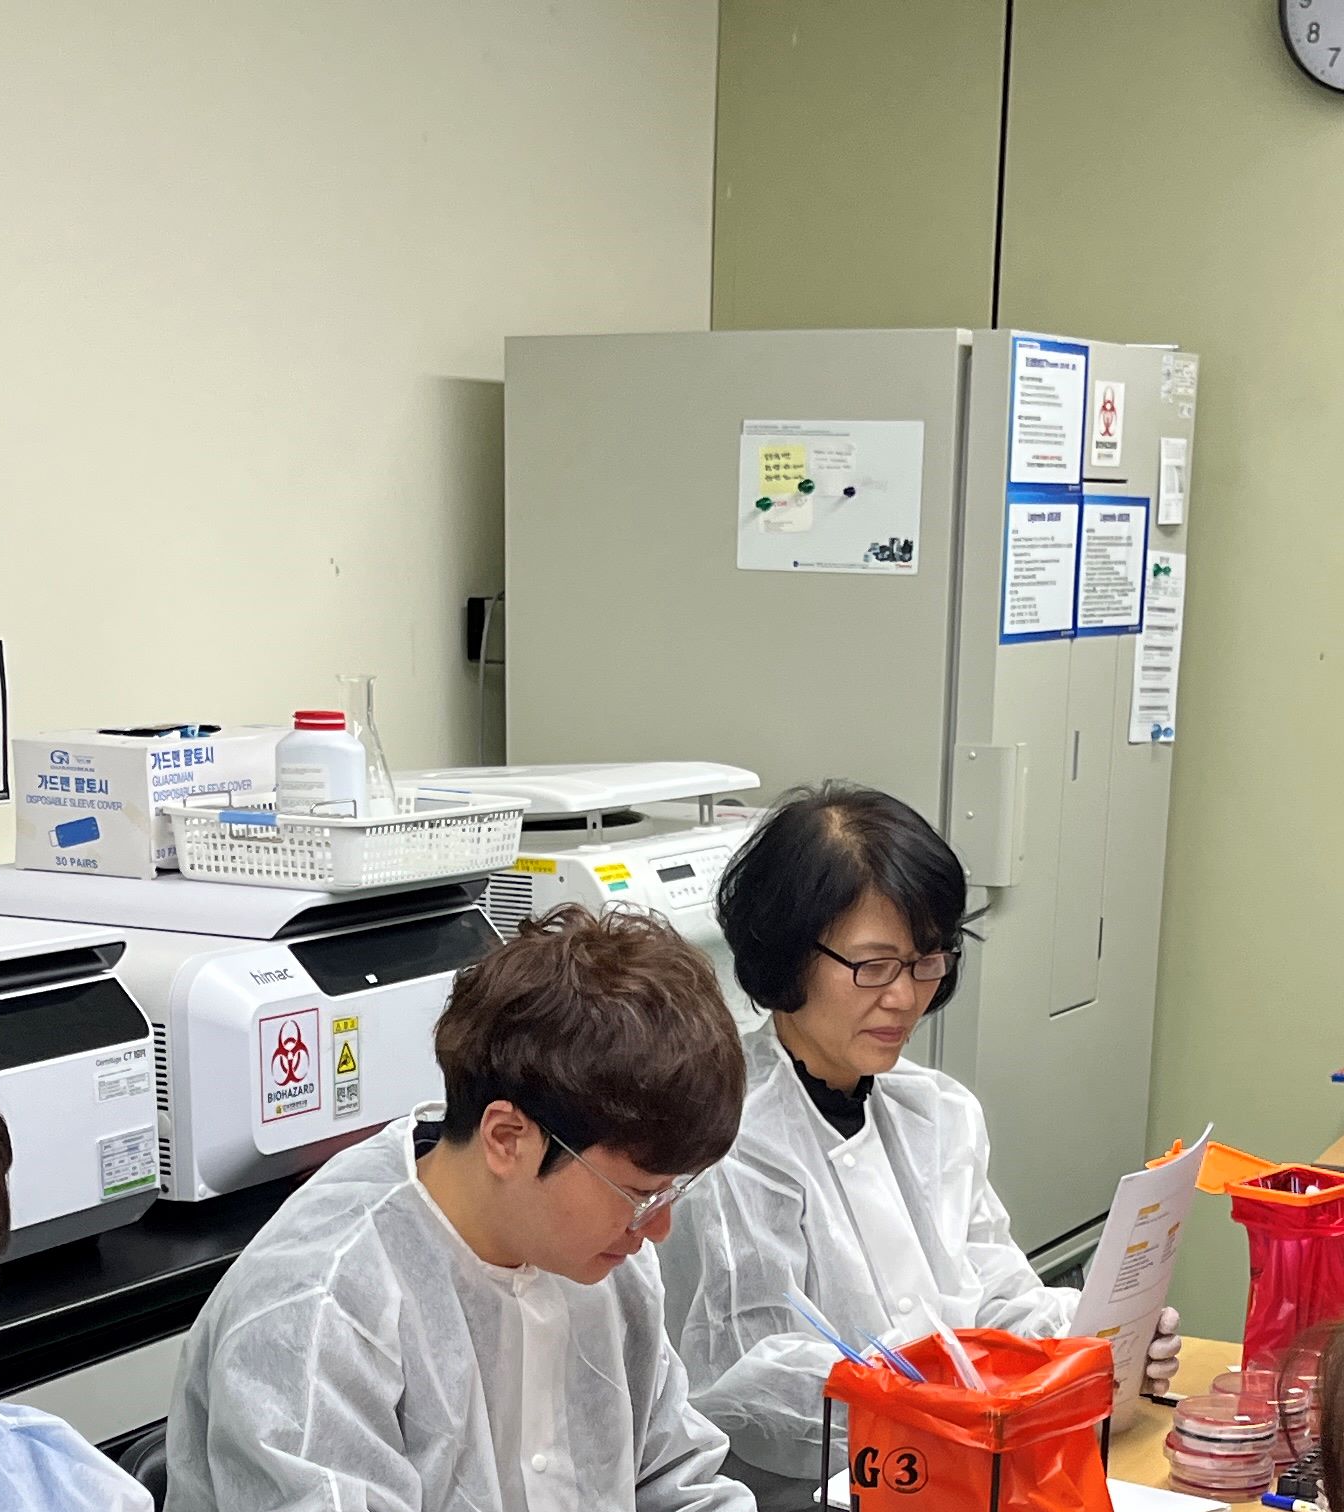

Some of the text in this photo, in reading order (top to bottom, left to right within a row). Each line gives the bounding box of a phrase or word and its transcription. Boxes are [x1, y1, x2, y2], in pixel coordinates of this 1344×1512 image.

[1307, 22, 1320, 43] 8
[1328, 47, 1342, 67] 7
[150, 746, 214, 770] 가드맨 팔토시
[38, 774, 109, 795] 가드맨 팔토시
[152, 771, 194, 787] GUARDMAN
[153, 785, 196, 802] DISPOSABLE
[227, 779, 252, 792] COVER
[26, 794, 123, 811] DISPOSABLE SLEEVE COVER
[56, 856, 98, 868] 30 PAIRS
[249, 968, 294, 986] himac
[267, 1083, 315, 1104] BIOHAZARD
